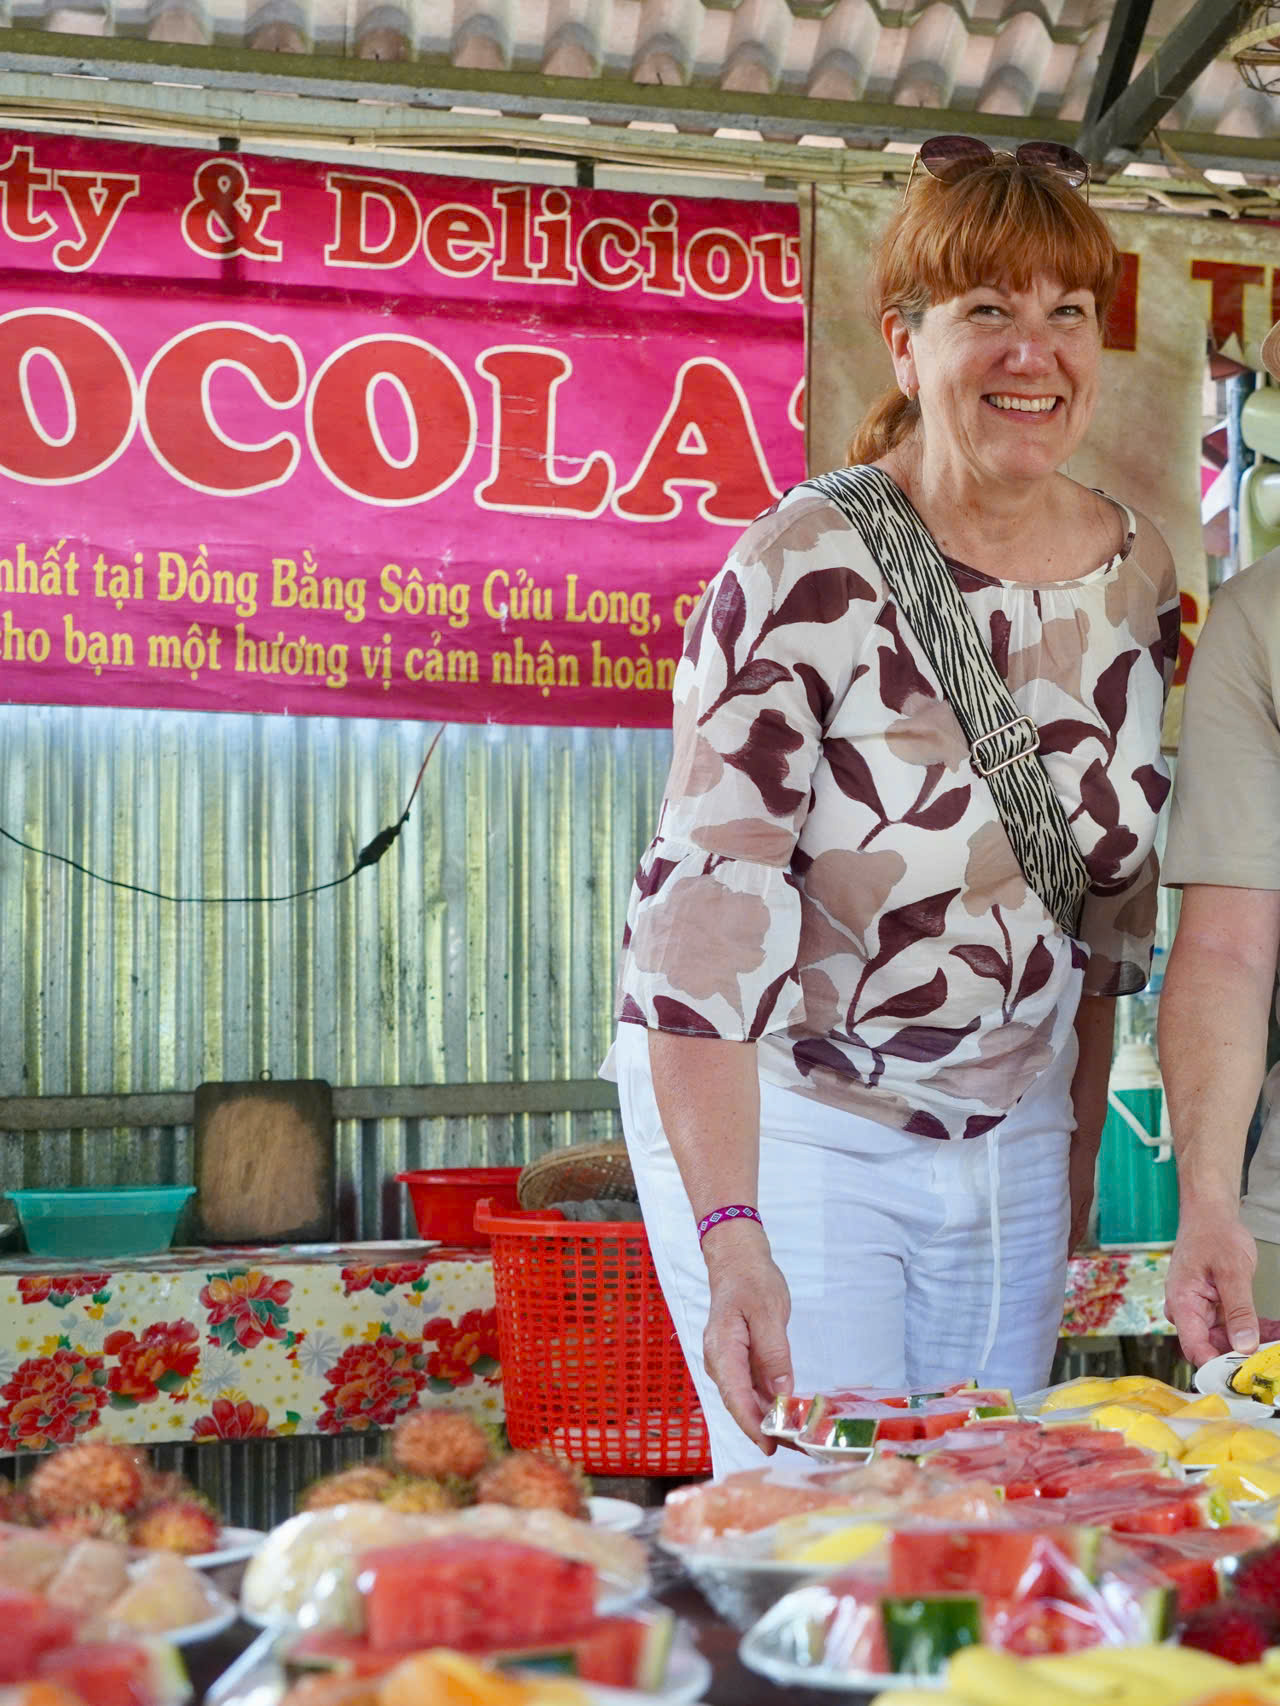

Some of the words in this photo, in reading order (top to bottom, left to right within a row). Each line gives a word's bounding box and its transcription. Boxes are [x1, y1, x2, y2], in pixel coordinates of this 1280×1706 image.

[181, 158, 283, 262] &
[0, 306, 806, 526] OCOLA
[93, 551, 145, 611] tại
[157, 543, 259, 618] Đồng
[271, 549, 367, 624] Bằng
[378, 563, 471, 629] Sông
[482, 567, 553, 622] Cửu
[565, 573, 662, 637] Long,
[0, 609, 51, 664] ho
[63, 613, 135, 676] bạn
[147, 622, 222, 682] một
[234, 622, 349, 689] hương
[360, 632, 392, 691] vị
[404, 630, 480, 684] cảm
[491, 635, 581, 698] nhận
[591, 639, 676, 692] hoàn
